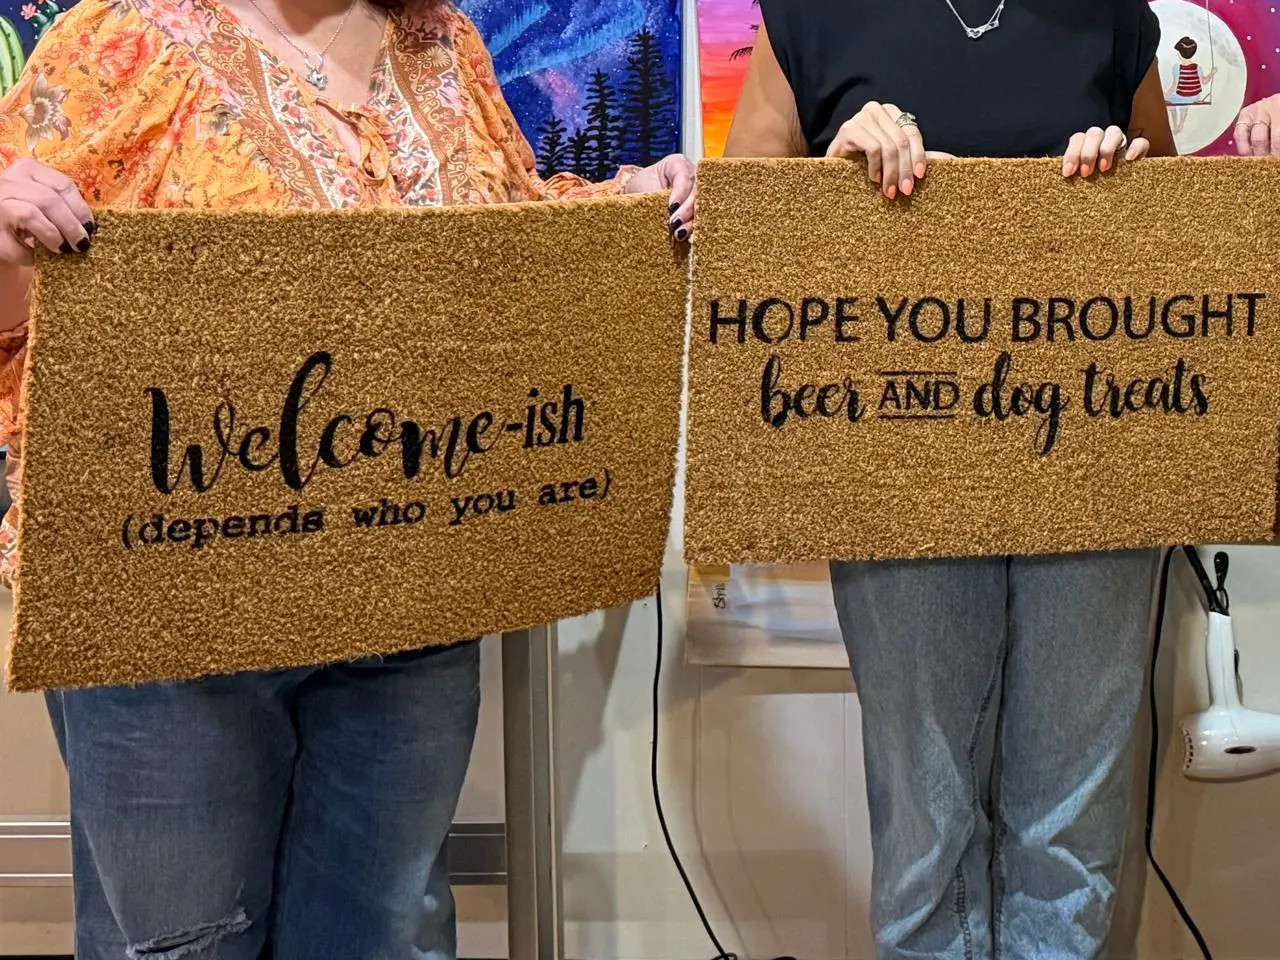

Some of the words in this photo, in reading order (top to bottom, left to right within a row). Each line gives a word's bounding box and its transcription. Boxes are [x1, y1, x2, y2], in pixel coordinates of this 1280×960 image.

[709, 296, 861, 344] HOPE
[875, 295, 992, 342] YOU
[1011, 292, 1267, 340] BROUGHT
[760, 353, 867, 429] beer
[877, 375, 961, 414] AND
[972, 351, 1072, 456] dog
[1083, 357, 1209, 420] treats
[121, 496, 325, 550] (depends
[353, 497, 426, 530] who
[449, 488, 517, 527] you
[537, 467, 611, 507] are)
